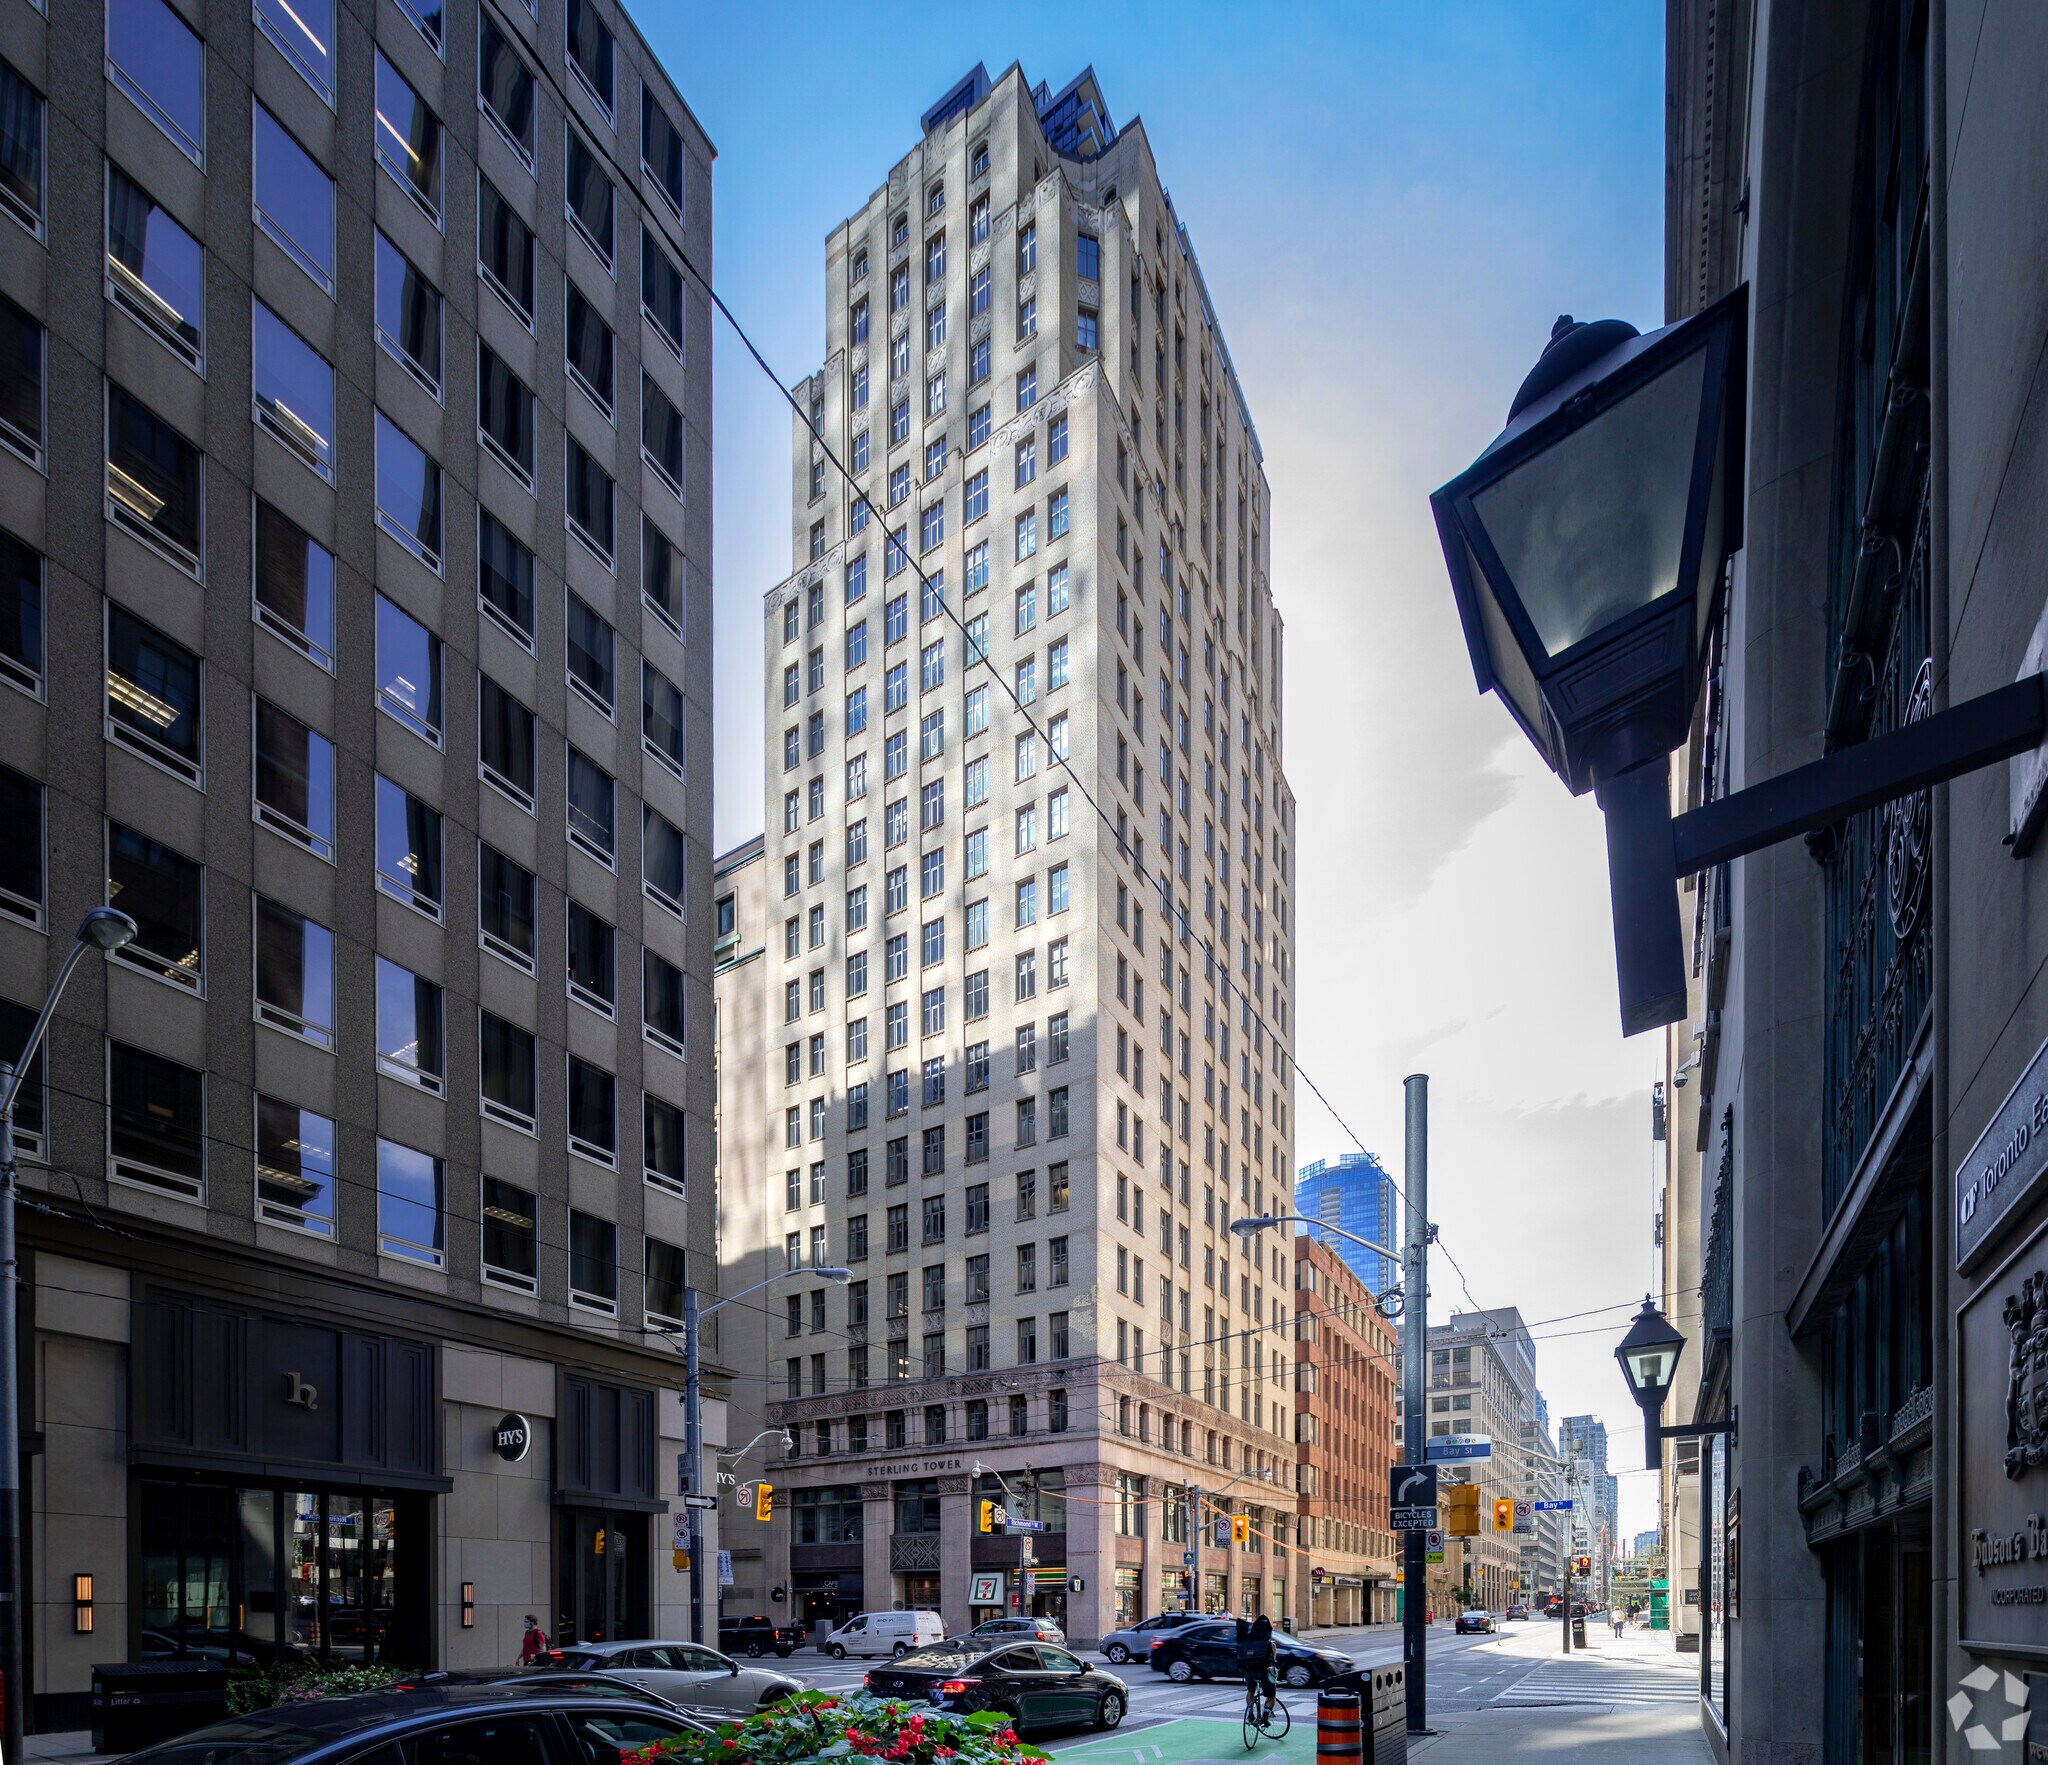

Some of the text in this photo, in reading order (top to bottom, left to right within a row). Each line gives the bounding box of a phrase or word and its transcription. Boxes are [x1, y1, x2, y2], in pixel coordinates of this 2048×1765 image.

[1980, 1124, 2030, 1199] Toronto
[497, 1429, 523, 1446] HY'S
[1442, 1446, 1473, 1456] Bay St
[867, 1459, 961, 1476] STERLING TOWER
[1543, 1502, 1558, 1510] Bay
[1394, 1510, 1432, 1519] BICYCLES
[1011, 1519, 1031, 1528] Richmond
[1392, 1519, 1434, 1528] EXCEPTED
[1971, 1527, 2023, 1577] Hudson's
[980, 1581, 993, 1599] 7
[1991, 1585, 2045, 1605] INCORPORATED
[111, 1698, 130, 1706] Litter
